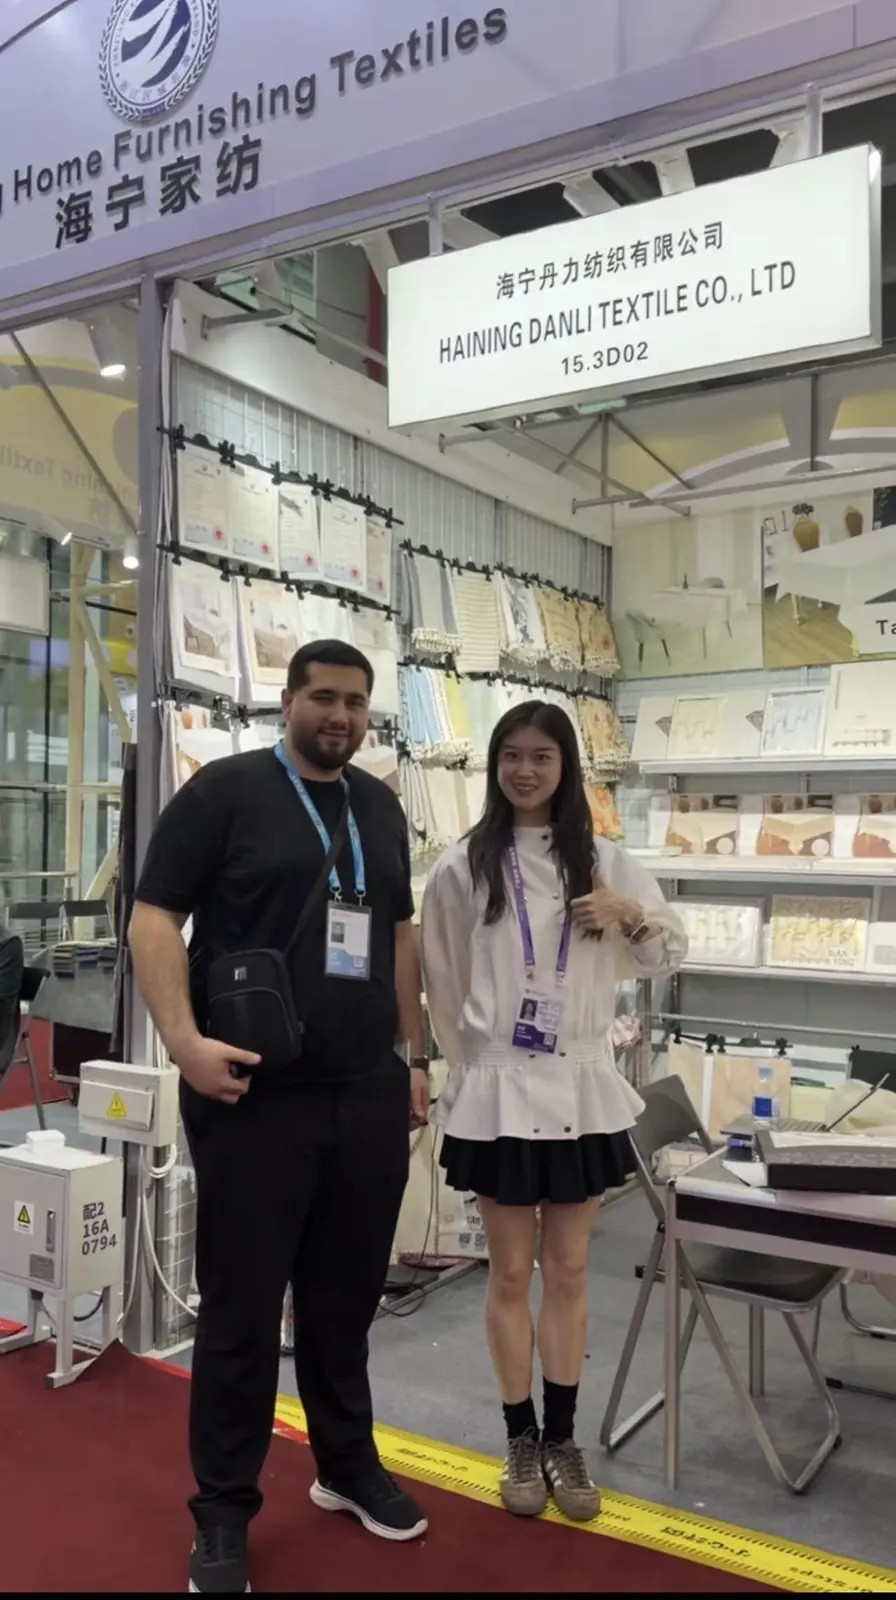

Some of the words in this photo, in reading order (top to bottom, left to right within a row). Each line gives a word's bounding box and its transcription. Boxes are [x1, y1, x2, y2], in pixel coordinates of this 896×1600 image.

[13, 149, 102, 203] Home
[114, 74, 316, 170] Furnishing
[330, 7, 507, 93] Textiles
[55, 135, 262, 249] 海宁家纺
[496, 221, 723, 300] 海宁丹力纺织有限公司
[439, 321, 523, 364] HAINING
[529, 306, 592, 344] DANLI
[598, 284, 688, 329] TEXTILE
[695, 275, 742, 308] CO.,
[751, 260, 796, 297] LTD
[560, 341, 648, 377] 15.3D02
[83, 1201, 105, 1221] 配2
[83, 1218, 110, 1239] 16A
[81, 1233, 117, 1256] 0794
